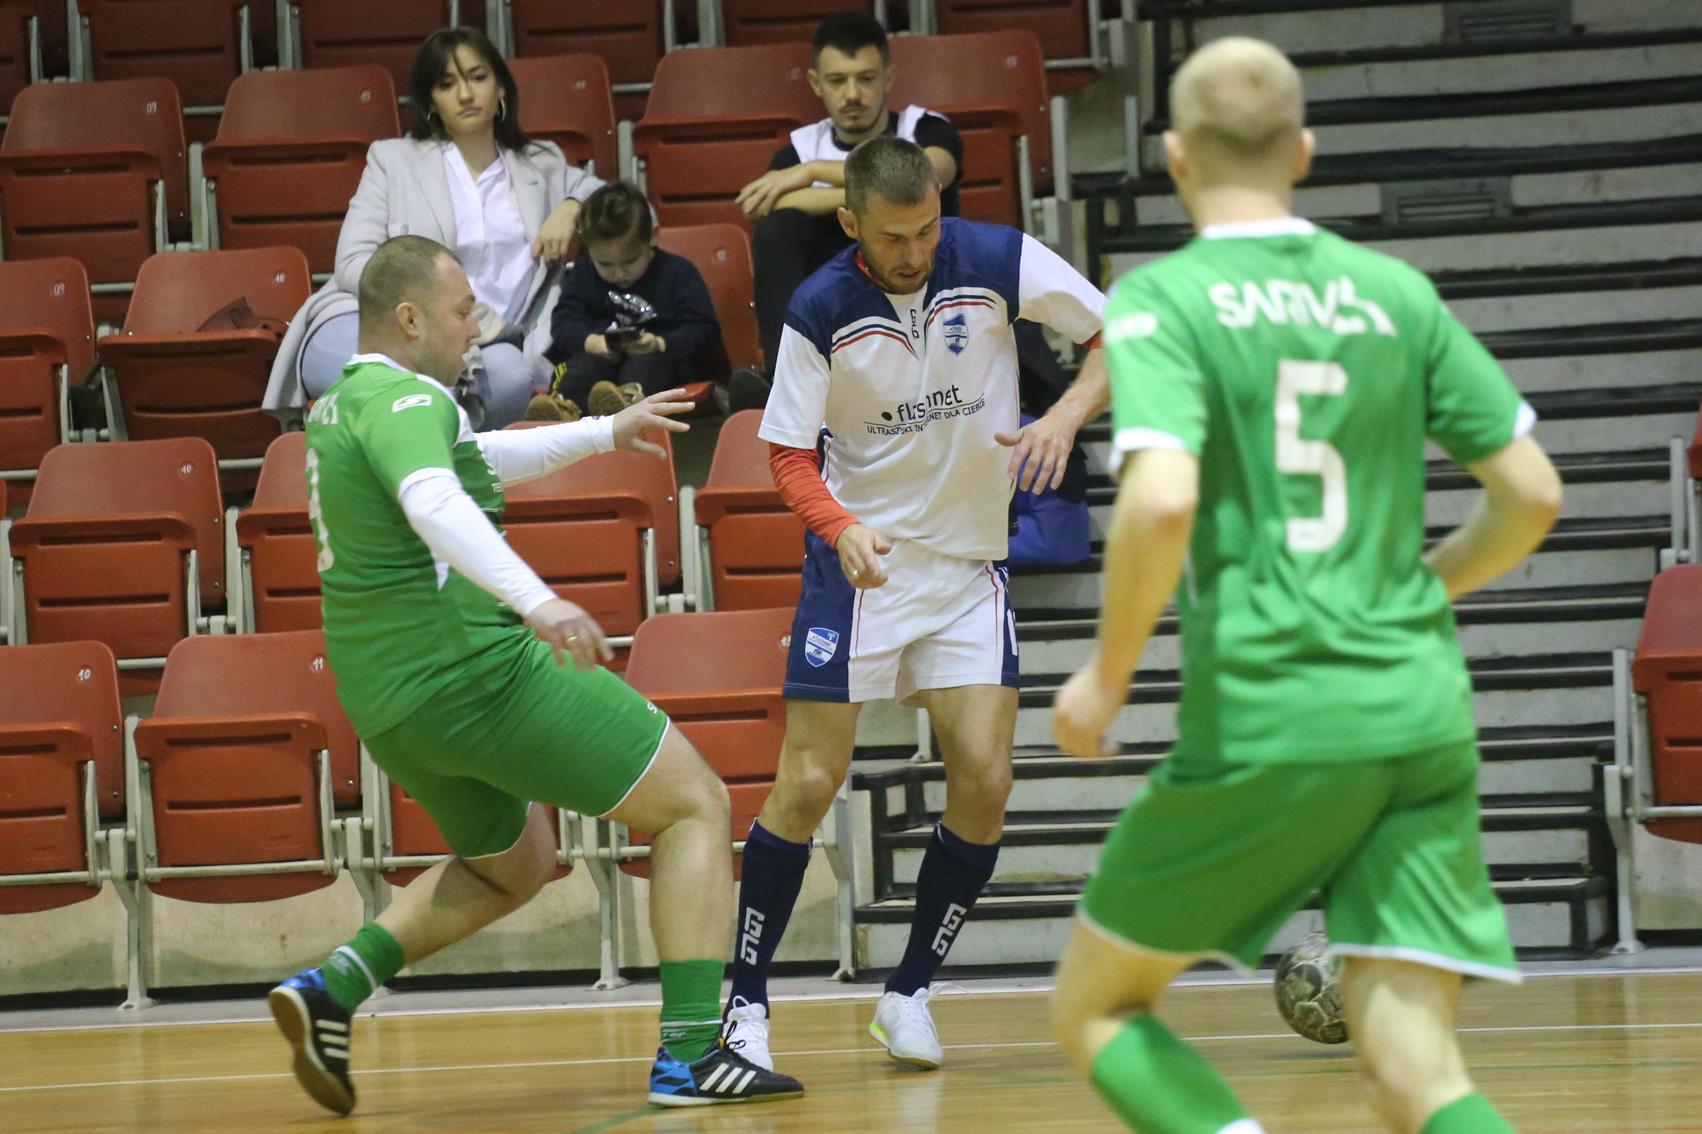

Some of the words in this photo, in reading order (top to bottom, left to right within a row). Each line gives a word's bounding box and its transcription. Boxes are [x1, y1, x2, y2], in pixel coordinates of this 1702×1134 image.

[943, 408, 961, 420] DLA
[1274, 357, 1349, 553] 5
[313, 656, 324, 670] 11
[78, 668, 92, 681] 10
